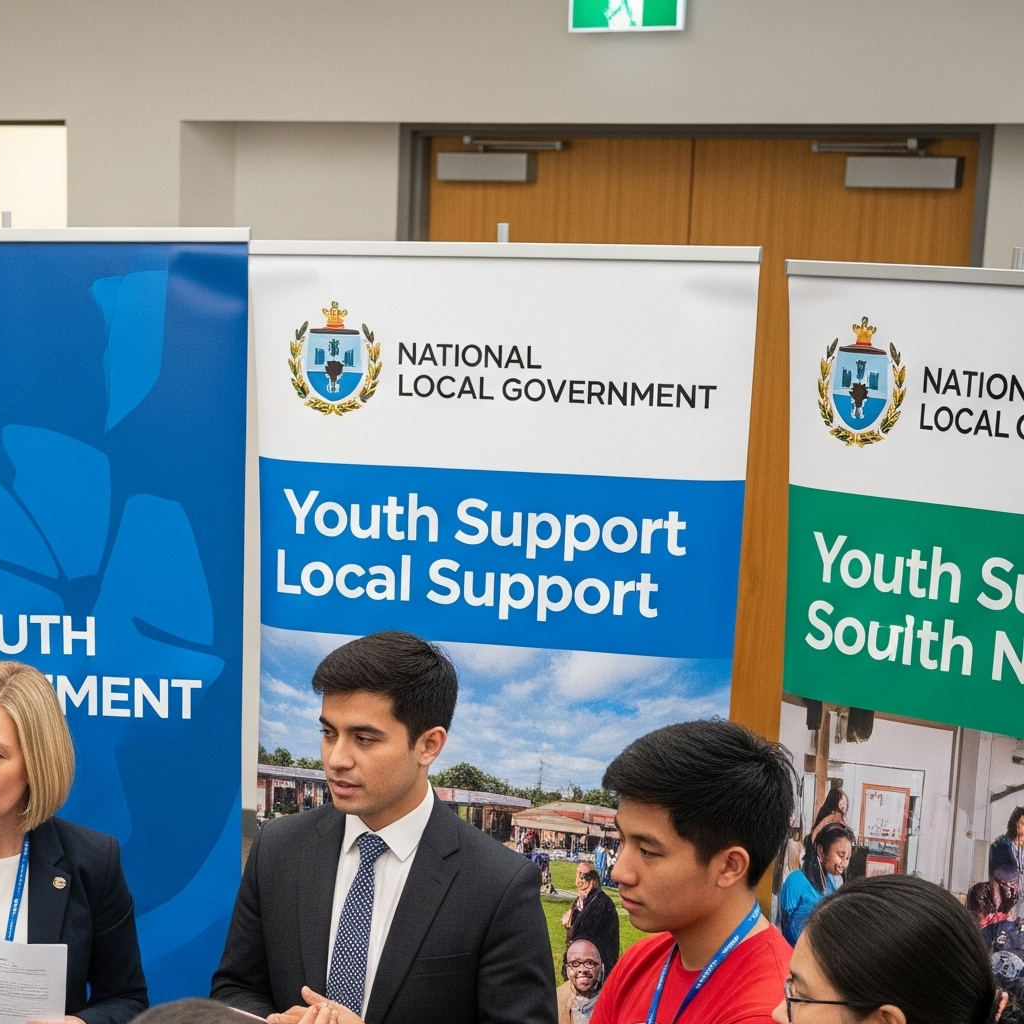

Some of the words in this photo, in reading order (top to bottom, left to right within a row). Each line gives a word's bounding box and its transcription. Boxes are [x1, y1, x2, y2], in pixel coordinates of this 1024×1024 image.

[398, 342, 542, 370] NATIONAL
[398, 374, 495, 401] LOCAL
[502, 377, 718, 410] GOVERNMENT
[919, 403, 1010, 439] LOCAL
[283, 488, 439, 543] Youth
[454, 497, 687, 562] Support
[276, 549, 411, 602] Local
[426, 558, 659, 622] Support
[813, 531, 962, 604] Youth
